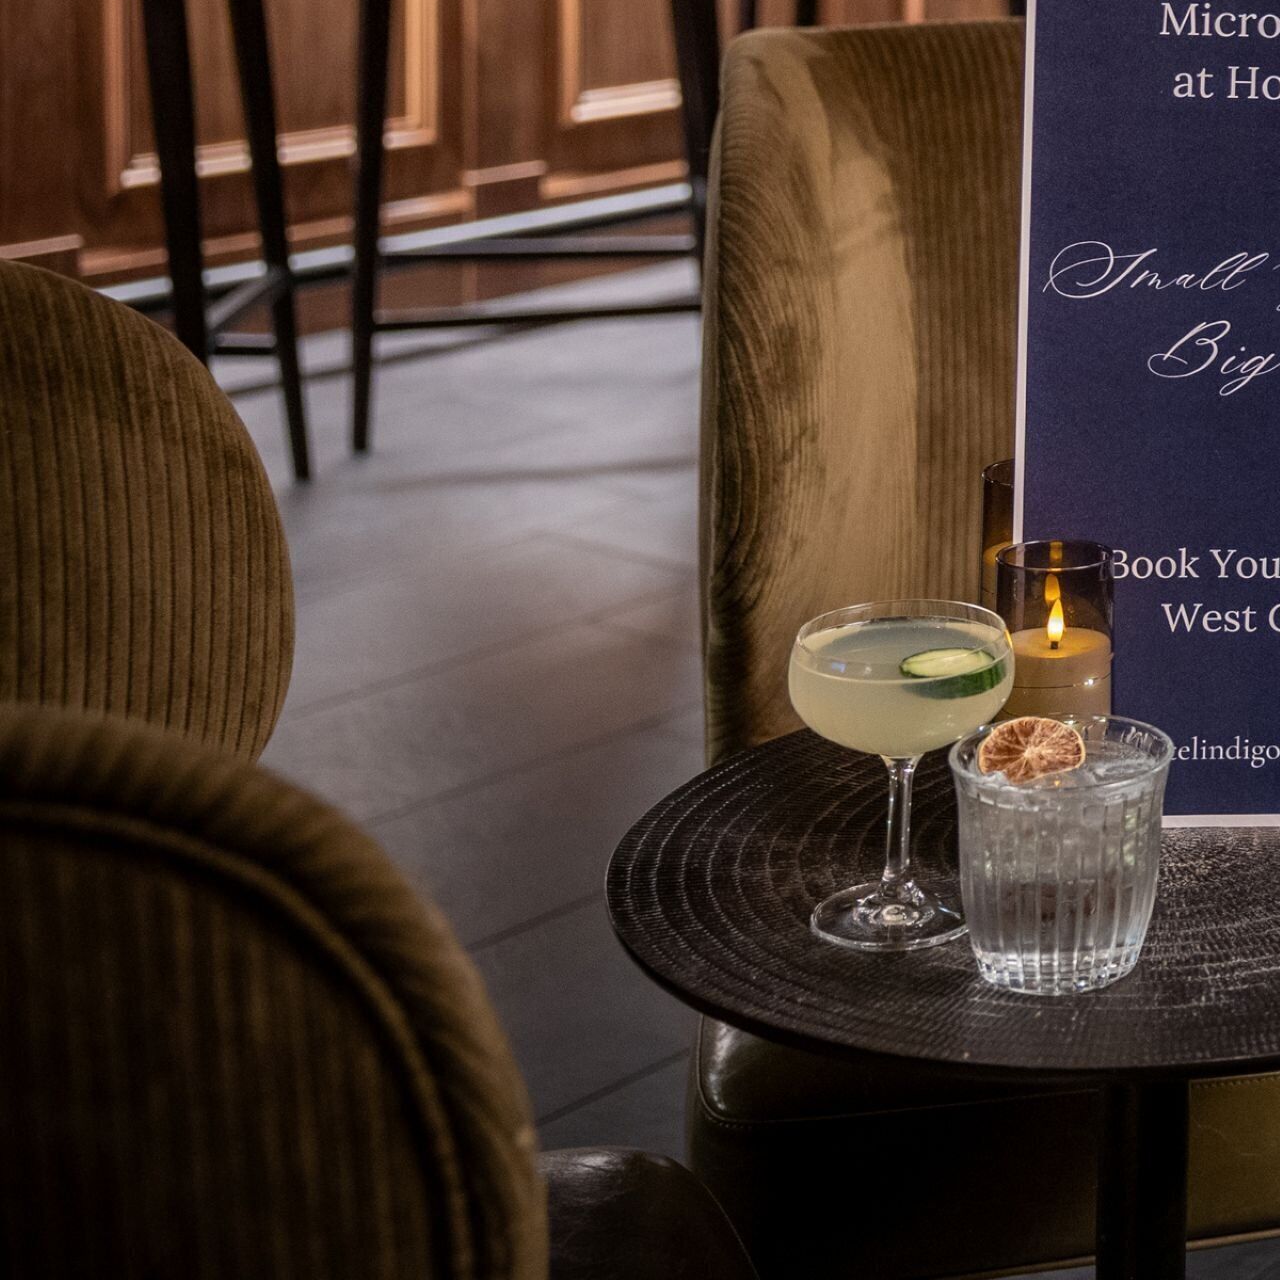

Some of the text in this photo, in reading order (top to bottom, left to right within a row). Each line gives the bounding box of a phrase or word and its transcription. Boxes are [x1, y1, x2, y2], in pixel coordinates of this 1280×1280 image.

[1172, 67, 1215, 99] at
[1042, 240, 1270, 300] Small
[1112, 547, 1200, 579] Book
[1160, 602, 1258, 633] West
